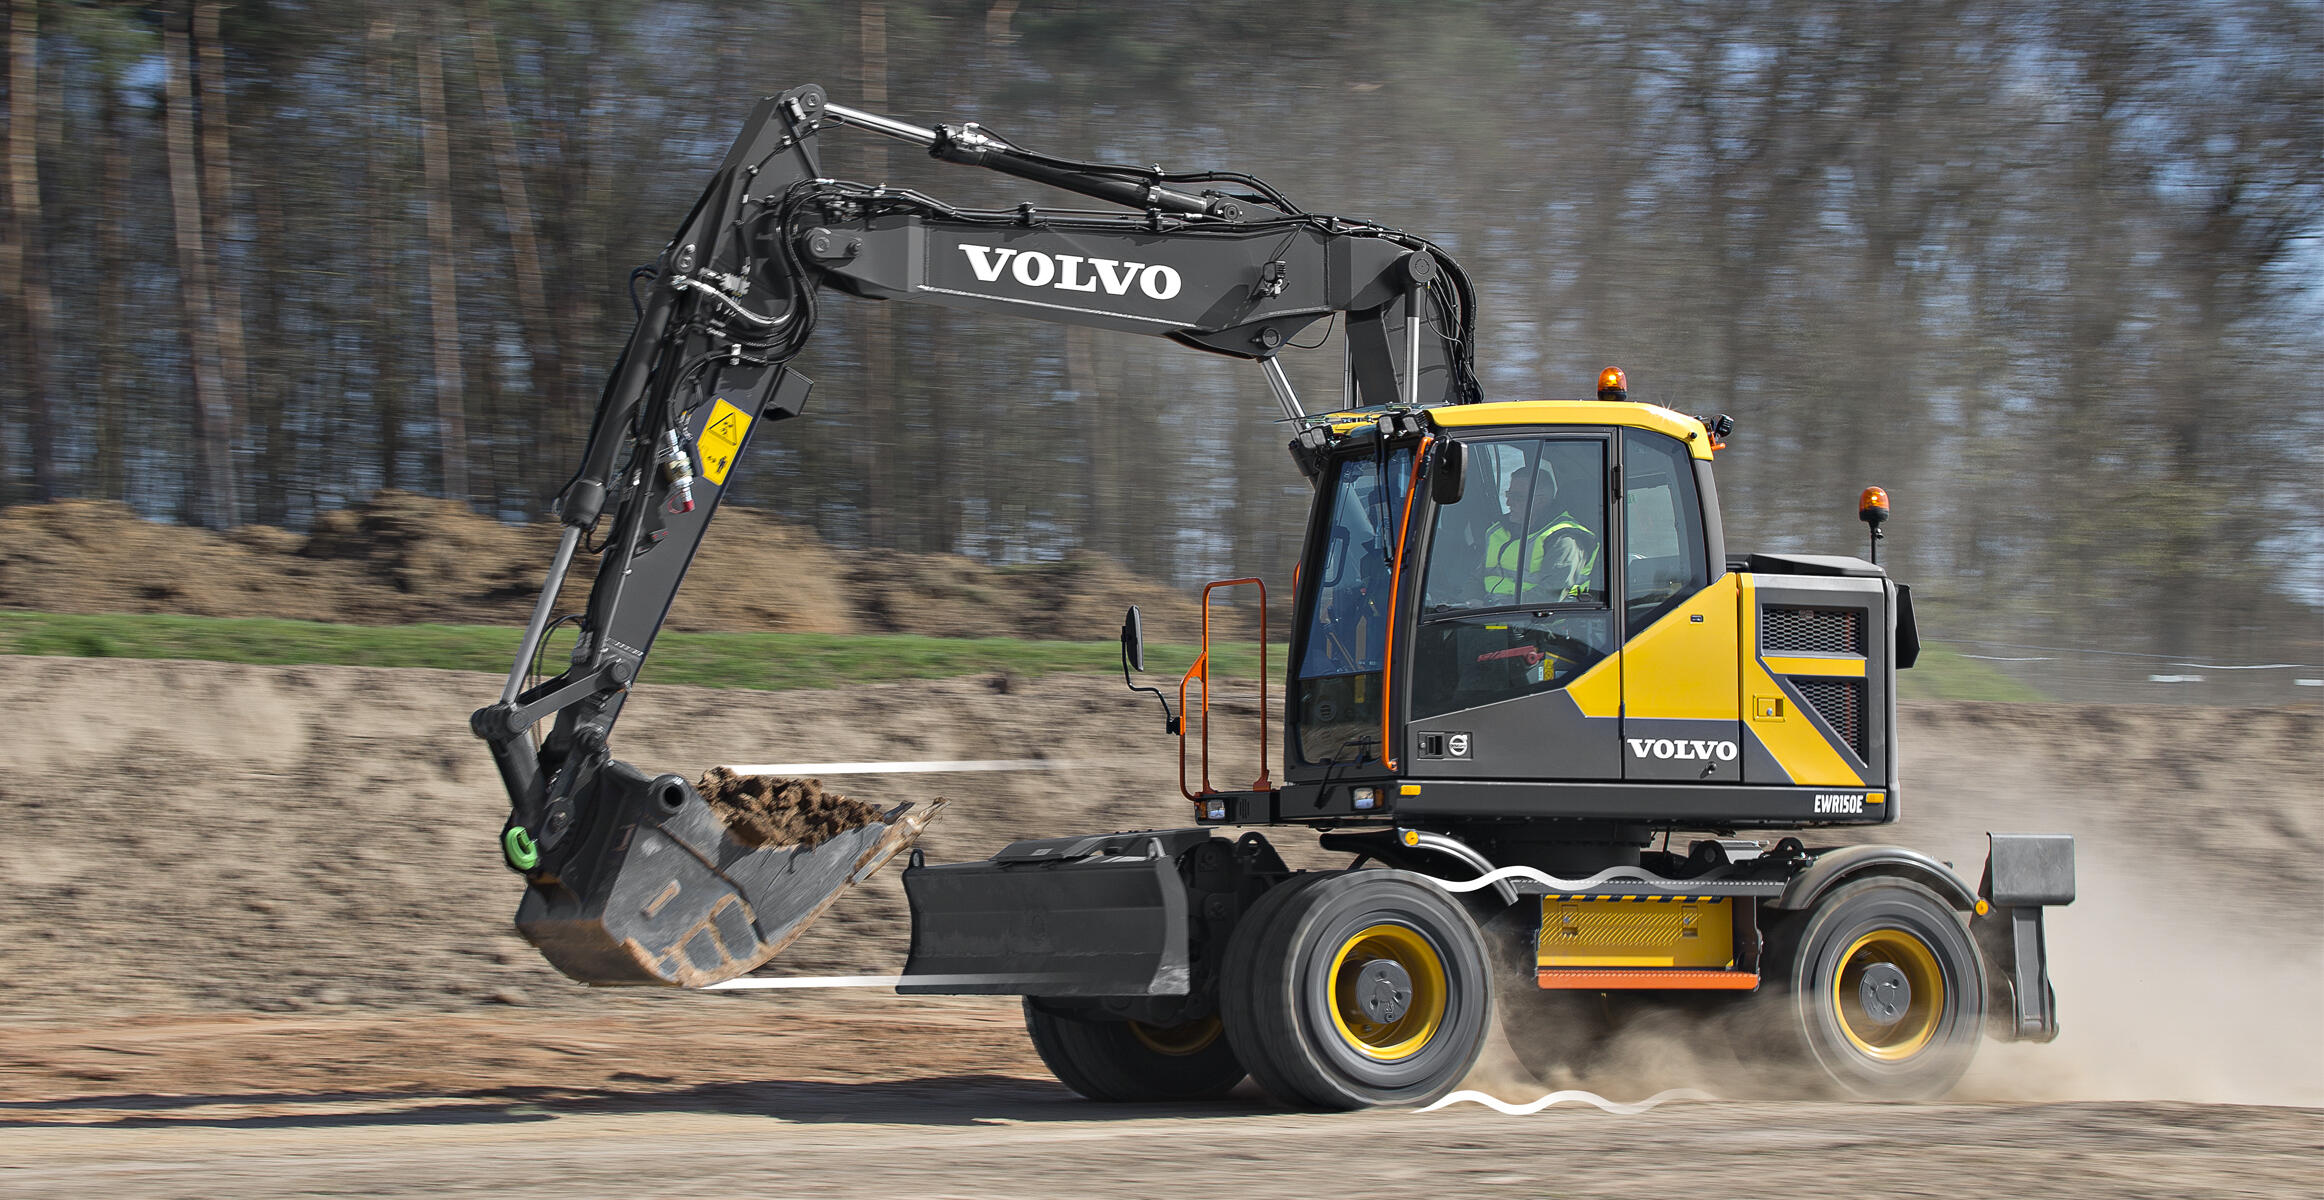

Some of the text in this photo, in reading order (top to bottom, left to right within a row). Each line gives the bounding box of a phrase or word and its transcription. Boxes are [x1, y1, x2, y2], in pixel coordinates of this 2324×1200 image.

[958, 244, 1182, 300] VOLVO
[1627, 738, 1738, 761] VOLVO
[1814, 794, 1864, 814] EWR150E
